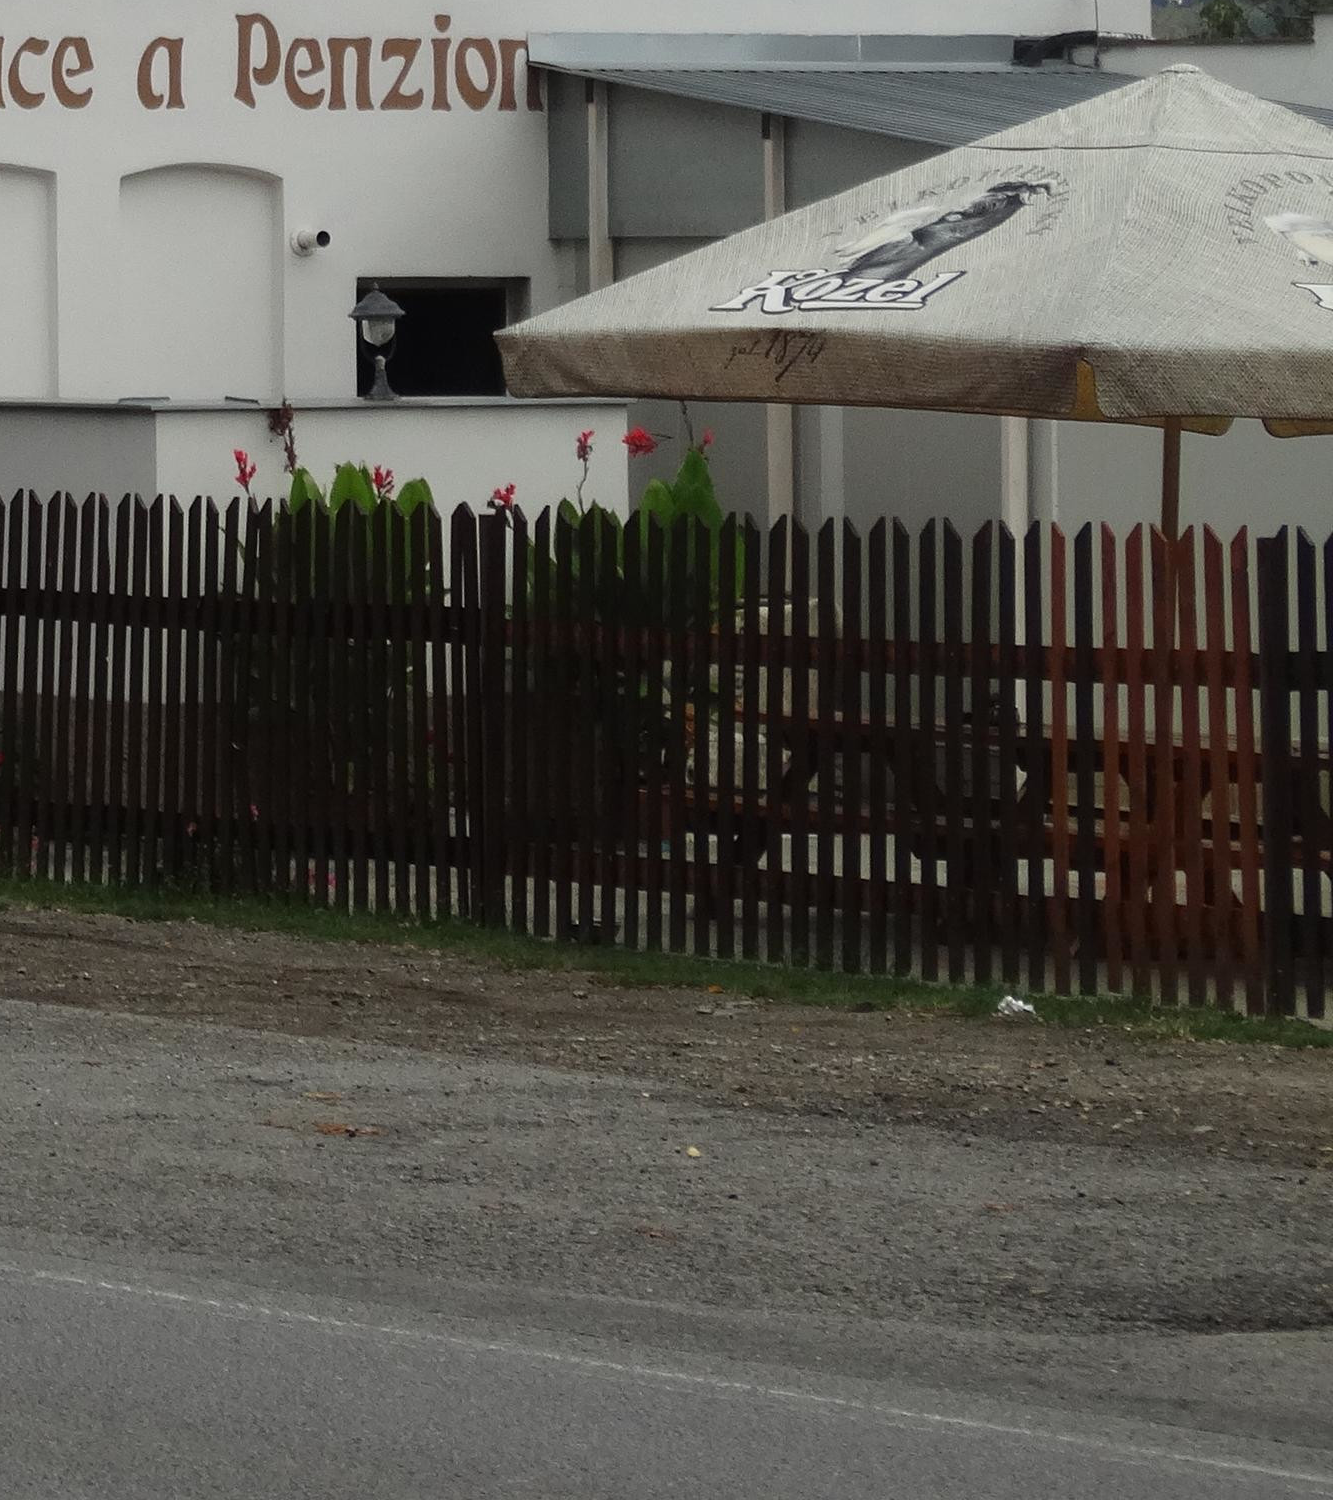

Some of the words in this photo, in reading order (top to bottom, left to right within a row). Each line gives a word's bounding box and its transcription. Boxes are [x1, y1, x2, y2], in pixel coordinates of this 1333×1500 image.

[137, 34, 186, 110] a
[234, 11, 545, 113] Penzion
[707, 268, 968, 313] Kozel
